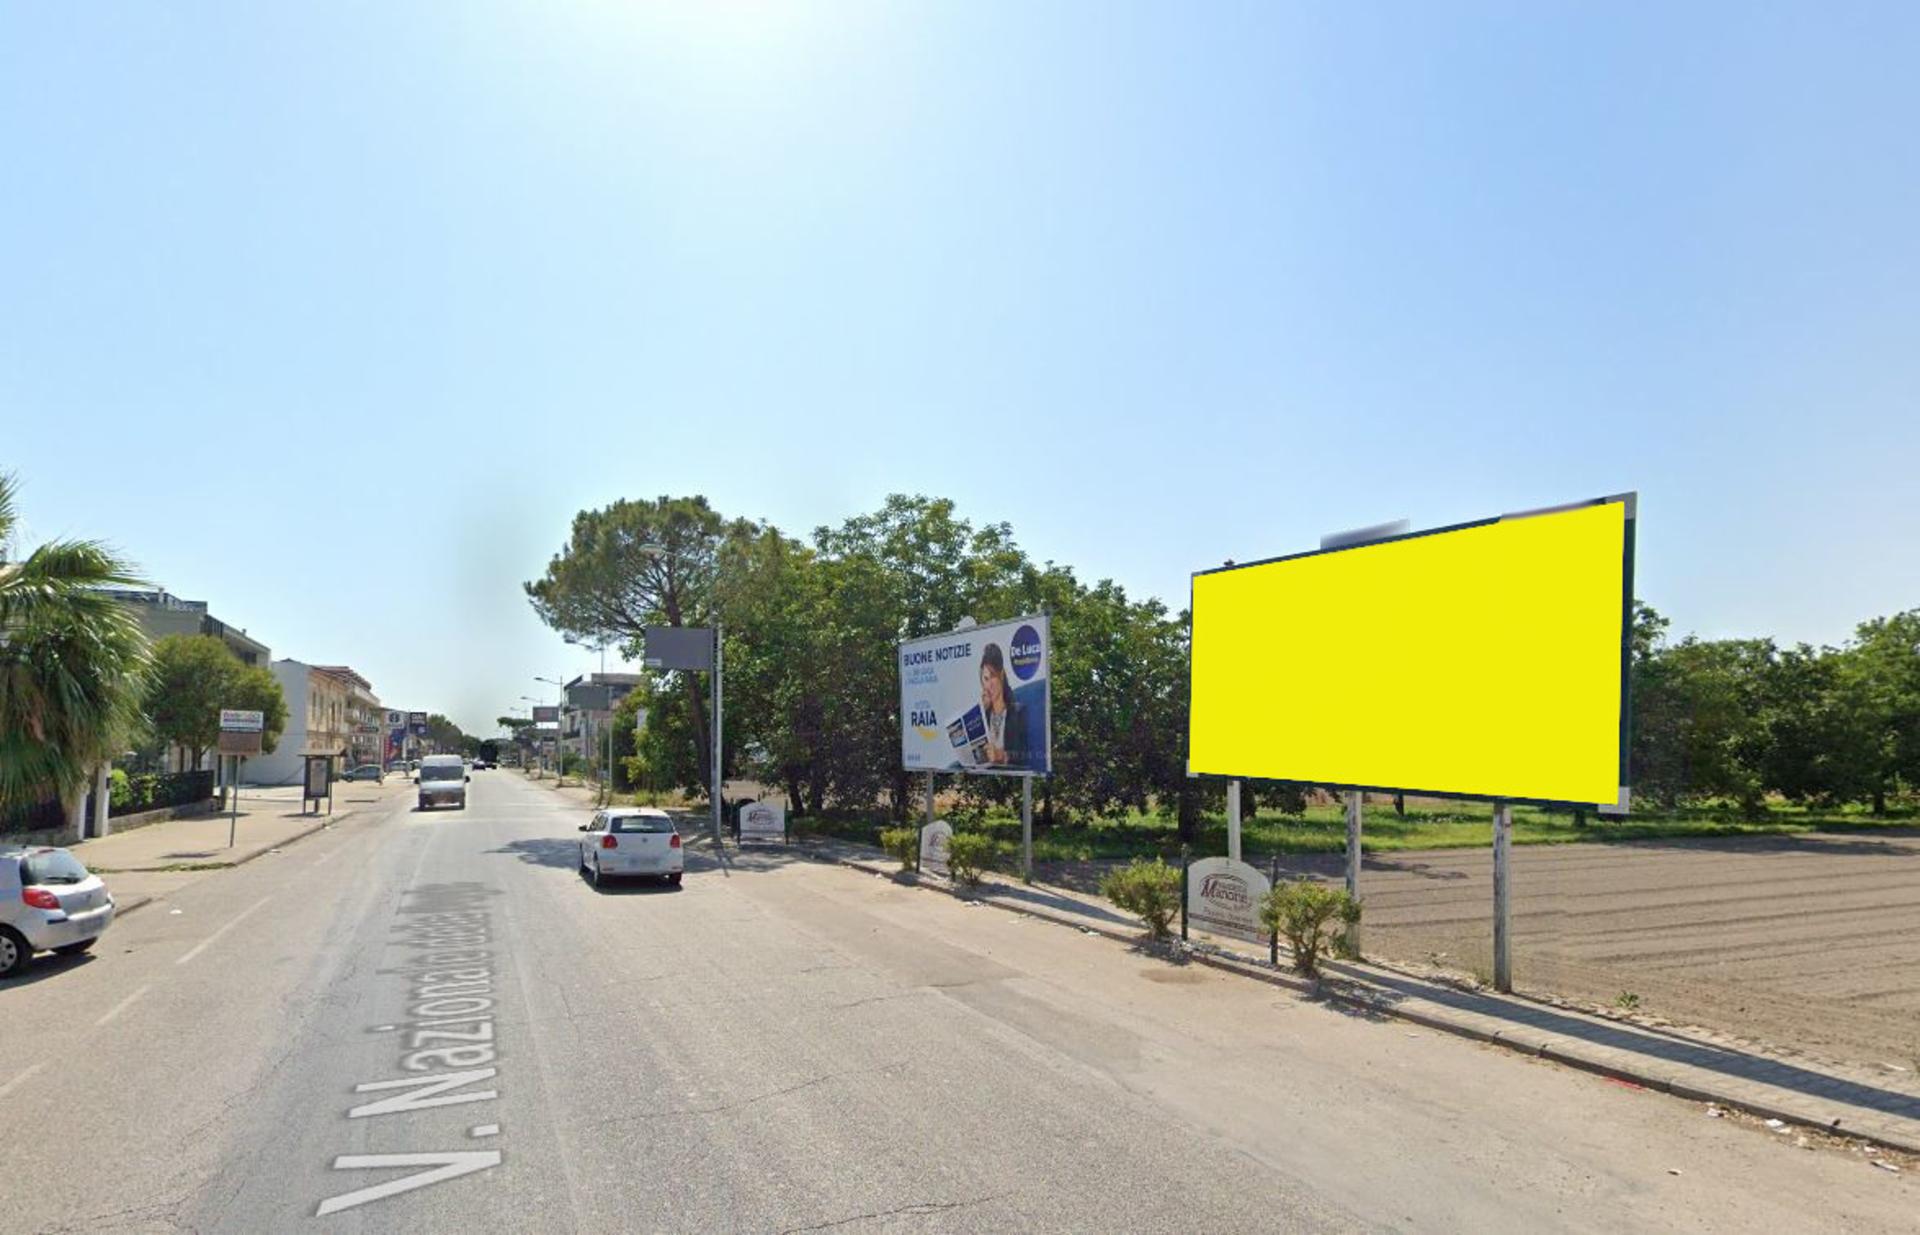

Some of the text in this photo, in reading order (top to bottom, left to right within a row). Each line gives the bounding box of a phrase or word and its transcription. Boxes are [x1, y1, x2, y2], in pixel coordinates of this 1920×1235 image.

[904, 643, 972, 666] BUONE NOTIZIE
[911, 710, 937, 726] RAIA
